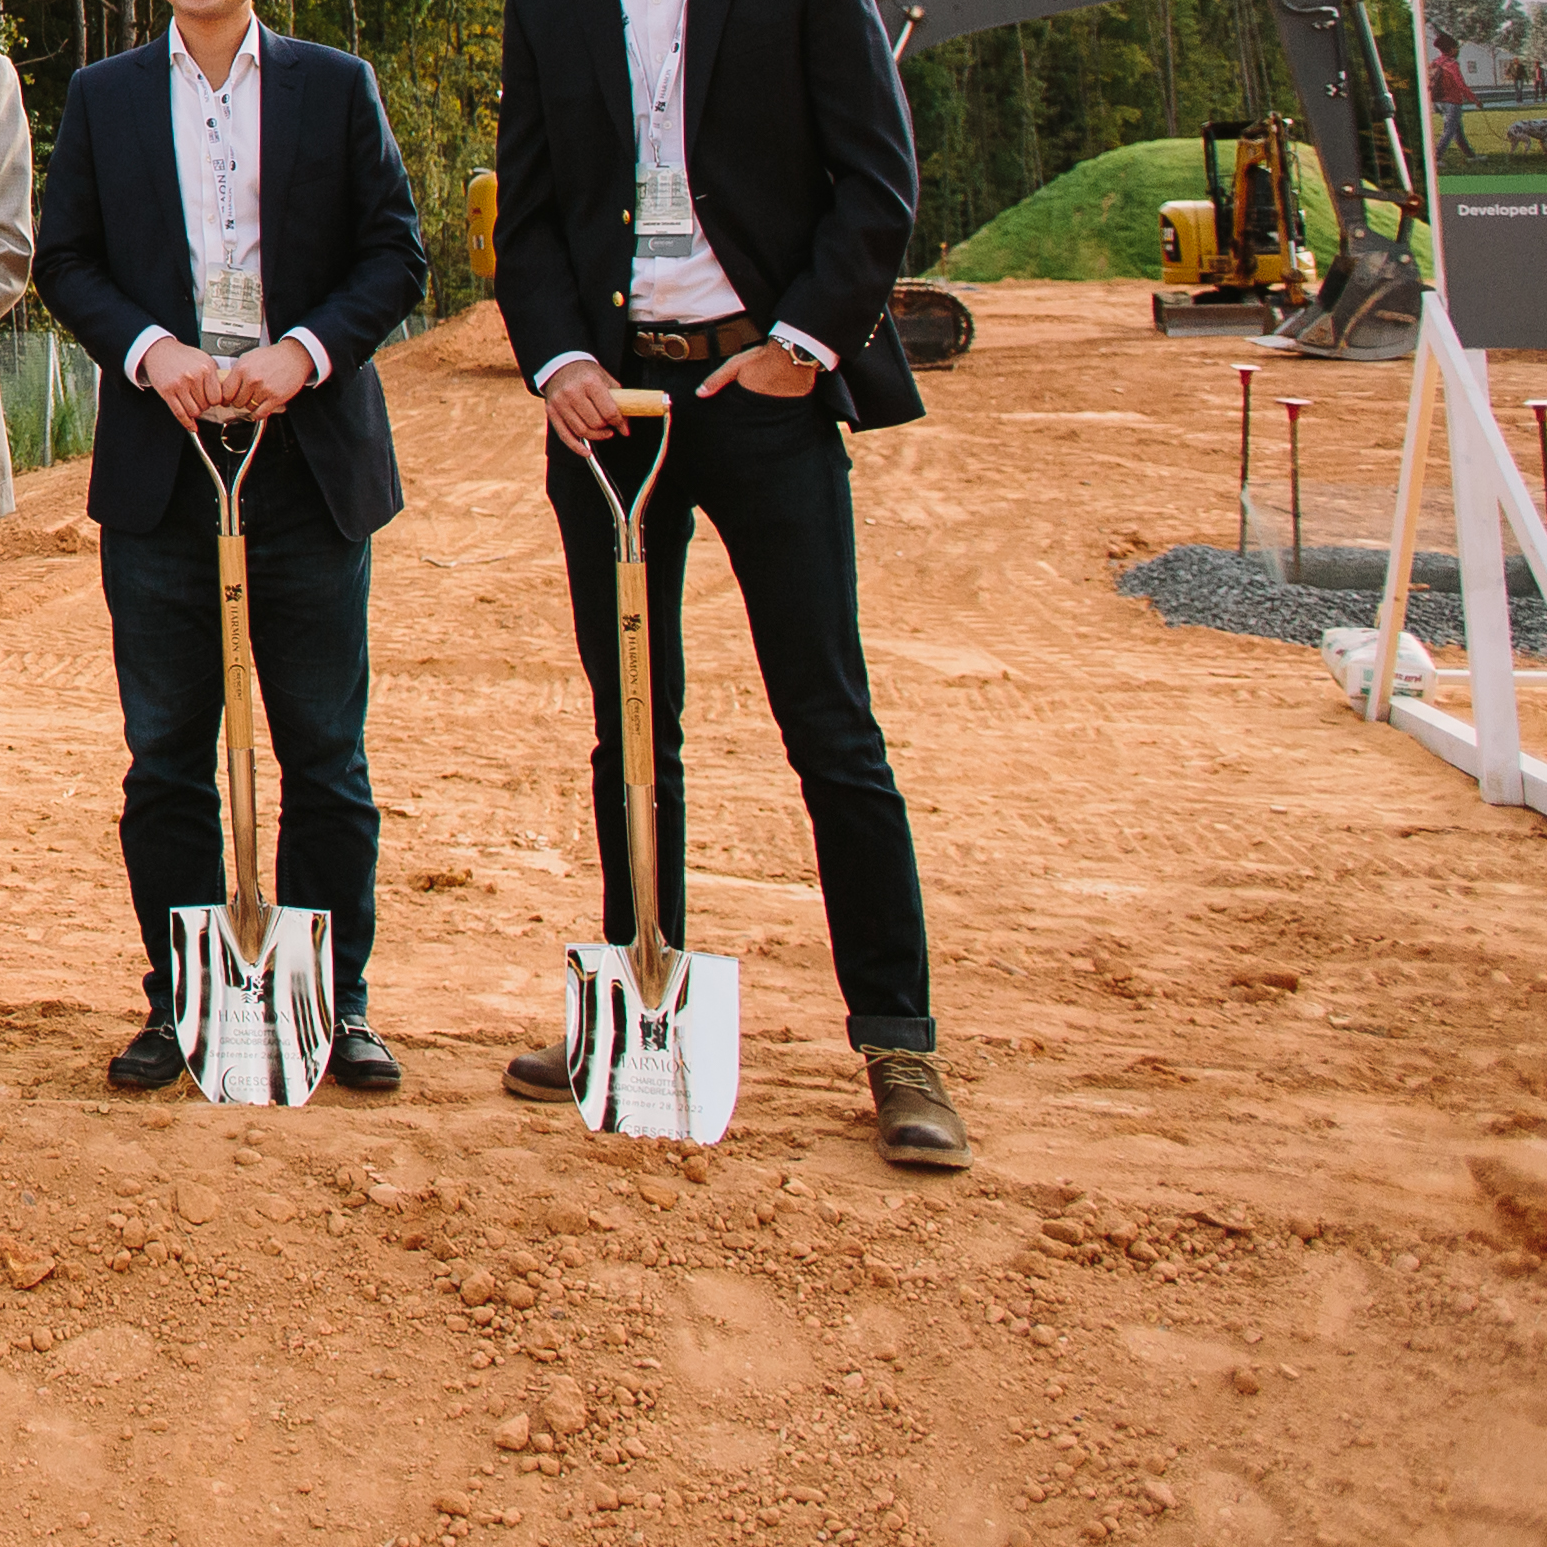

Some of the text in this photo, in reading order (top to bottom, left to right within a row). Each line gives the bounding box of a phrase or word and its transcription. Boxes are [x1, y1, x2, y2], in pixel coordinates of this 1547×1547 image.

[1457, 204, 1540, 217] Developed
[230, 605, 239, 653] HARMON
[628, 636, 638, 686] HARMON
[209, 1049, 258, 1059] September
[229, 1075, 292, 1086] CRESCT
[630, 1075, 677, 1087] CHARLOTTE
[614, 1082, 692, 1099] GROUNDBREAKING
[615, 1098, 657, 1110] ptember
[677, 1103, 704, 1114] 2022
[624, 1124, 691, 1140] CRESCENT
